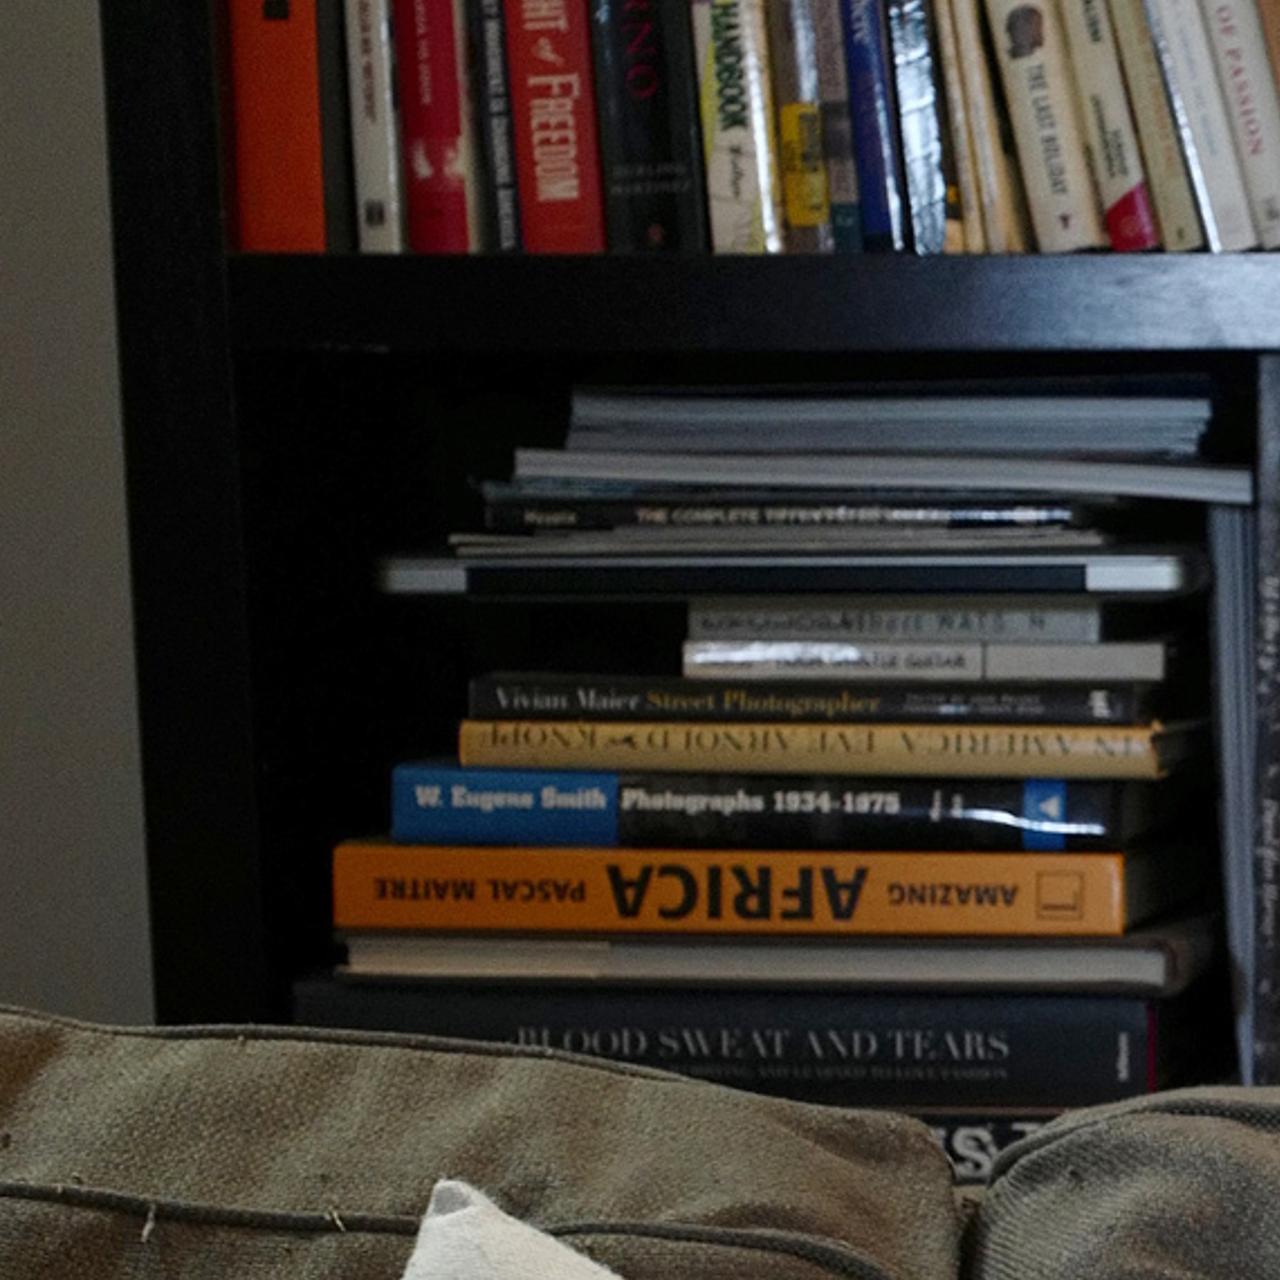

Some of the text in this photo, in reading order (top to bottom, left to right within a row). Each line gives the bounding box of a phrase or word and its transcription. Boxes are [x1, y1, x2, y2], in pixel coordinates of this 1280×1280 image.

[1225, 47, 1267, 157] PASSION
[496, 687, 570, 711] Vivian
[576, 687, 641, 711] Maier
[645, 689, 718, 712] Street
[723, 689, 882, 717] Photographer
[645, 728, 792, 754] ARNOLD
[899, 731, 1071, 757] AMERICA
[414, 785, 901, 815] W. Eugene Smith Photographs 1934-1975
[373, 863, 1019, 921] AMAZING AFRICA PASCAL MAITRE
[515, 1026, 1010, 1060] BLOOD SWEAT AND TEARS
